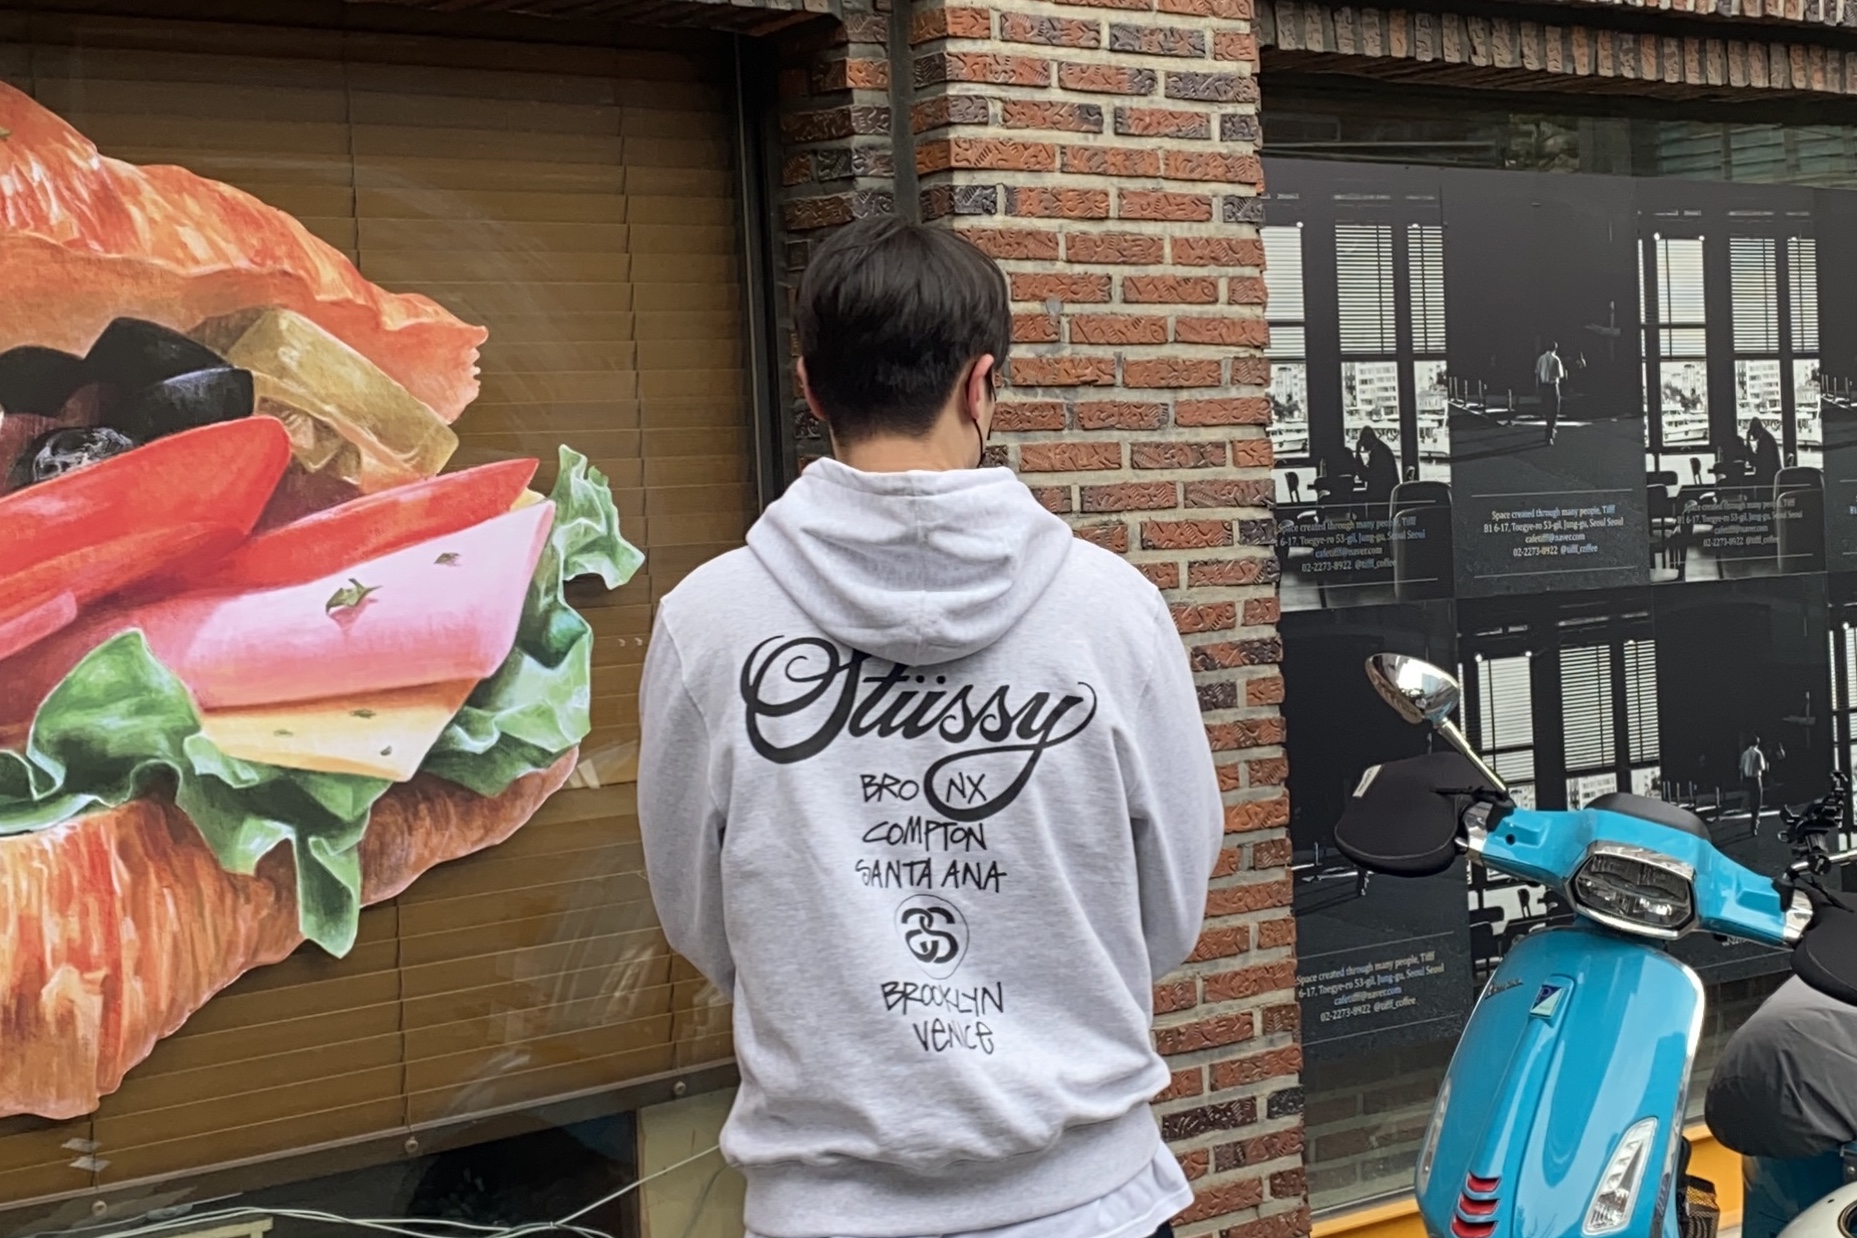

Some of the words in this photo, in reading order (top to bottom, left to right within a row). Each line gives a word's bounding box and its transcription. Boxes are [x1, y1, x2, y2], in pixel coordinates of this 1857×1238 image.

[1300, 521, 1326, 532] created
[1327, 519, 1355, 531] through
[1356, 519, 1375, 531] many
[1492, 510, 1511, 522] Space
[1511, 508, 1535, 519] created
[1536, 507, 1560, 519] through
[1561, 508, 1579, 518] many
[1511, 521, 1543, 534] Toegye-ro
[1589, 518, 1606, 527] Seoul
[1607, 517, 1624, 527] Seoul
[1300, 535, 1335, 547] Toegye-ro
[1387, 531, 1406, 541] Seoul
[1407, 529, 1426, 540] Seoul
[740, 635, 1097, 822] Stüssy
[862, 816, 988, 851] COMPTON
[855, 857, 932, 890] SANTA
[941, 860, 1007, 893] ANA
[1297, 973, 1318, 987] Space
[1318, 967, 1345, 981] created
[1346, 961, 1373, 976] through
[1374, 960, 1394, 971] many
[1319, 982, 1354, 996] Toegye-ro
[1406, 966, 1425, 980] Seoul
[1426, 963, 1445, 976] Seoul
[880, 981, 1003, 1016] BROOKLYN
[1320, 1004, 1371, 1023] 02-2273-8922
